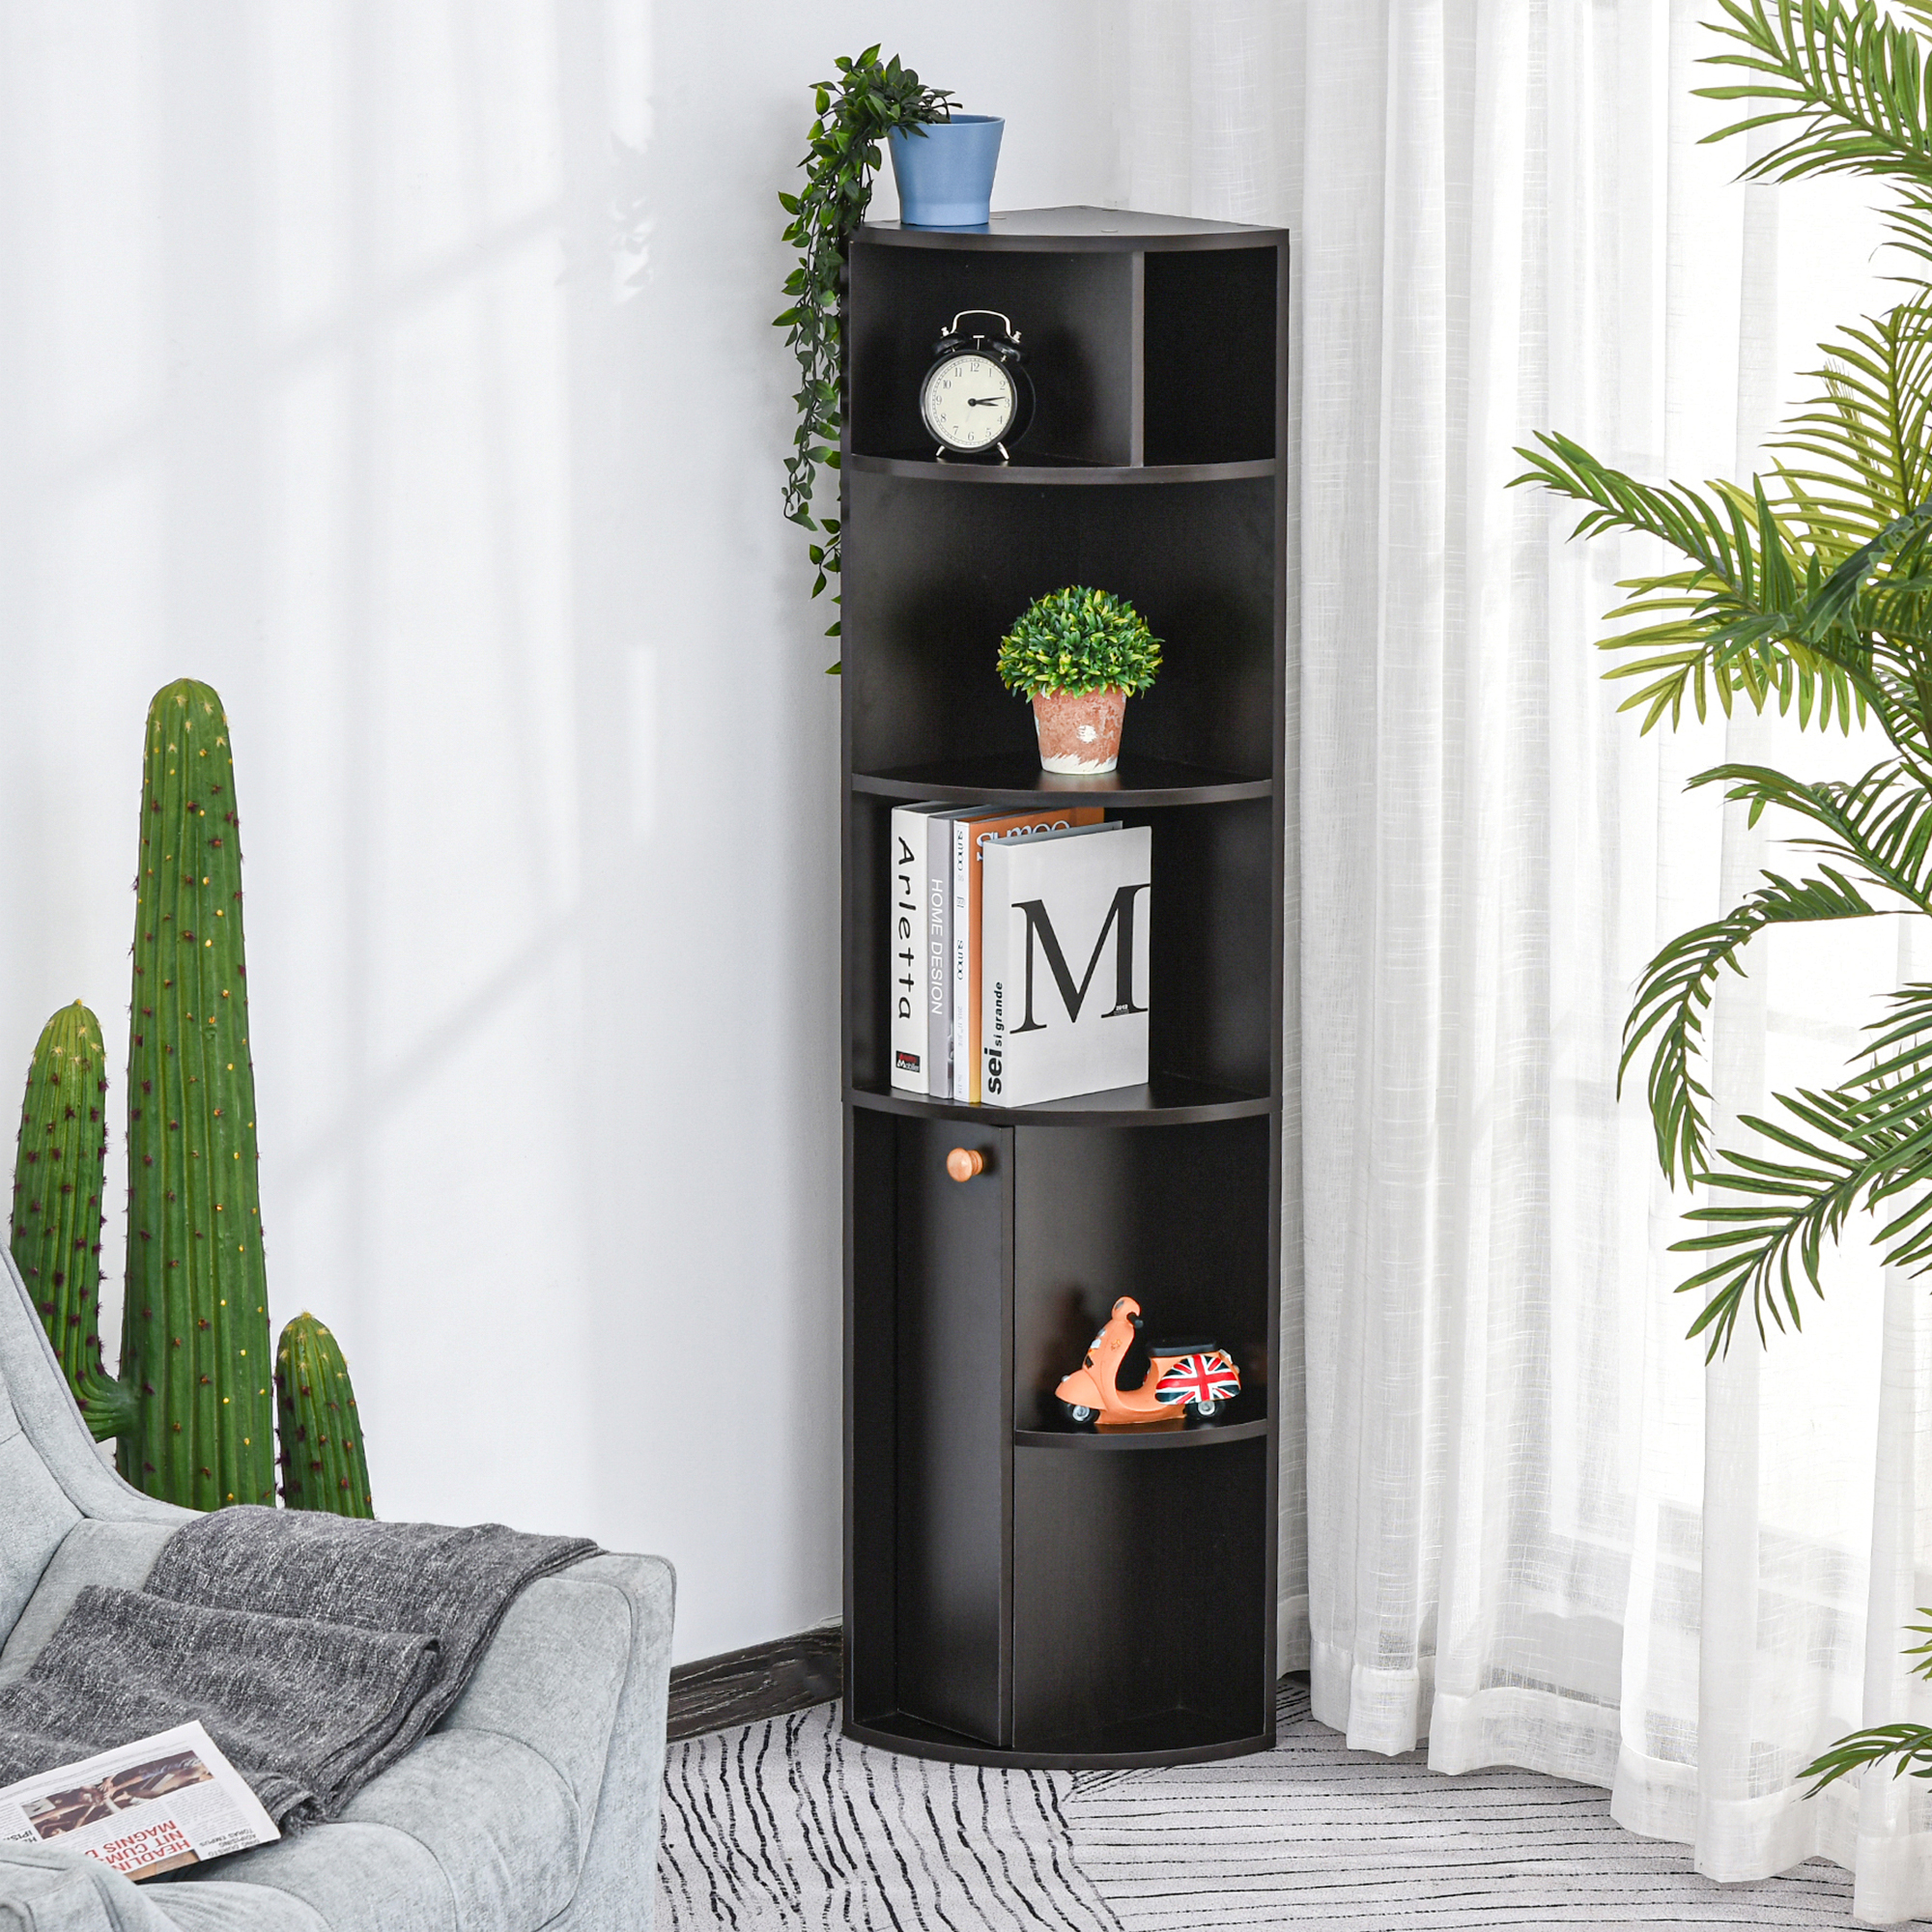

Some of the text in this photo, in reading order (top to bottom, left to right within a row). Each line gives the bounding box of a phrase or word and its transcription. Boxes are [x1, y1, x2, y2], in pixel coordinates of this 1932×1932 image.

[954, 367, 962, 377] 11
[970, 362, 980, 373] 12
[988, 367, 992, 377] 1
[943, 380, 952, 389] 10
[999, 381, 1006, 390] 2
[936, 395, 942, 405] 9
[1005, 398, 1010, 408] 3
[940, 413, 947, 422] 8
[997, 415, 1003, 424] 4
[952, 425, 958, 435] 7
[985, 428, 991, 438] 5
[968, 431, 974, 440] 6
[898, 837, 916, 1019] Arletta
[931, 879, 943, 1014] HOME DESIGN
[1009, 883, 1151, 1034] M
[983, 981, 1005, 1095] sei si grande
[102, 1820, 177, 1853] MAGNIS
[105, 1830, 185, 1864] NIT CUM
